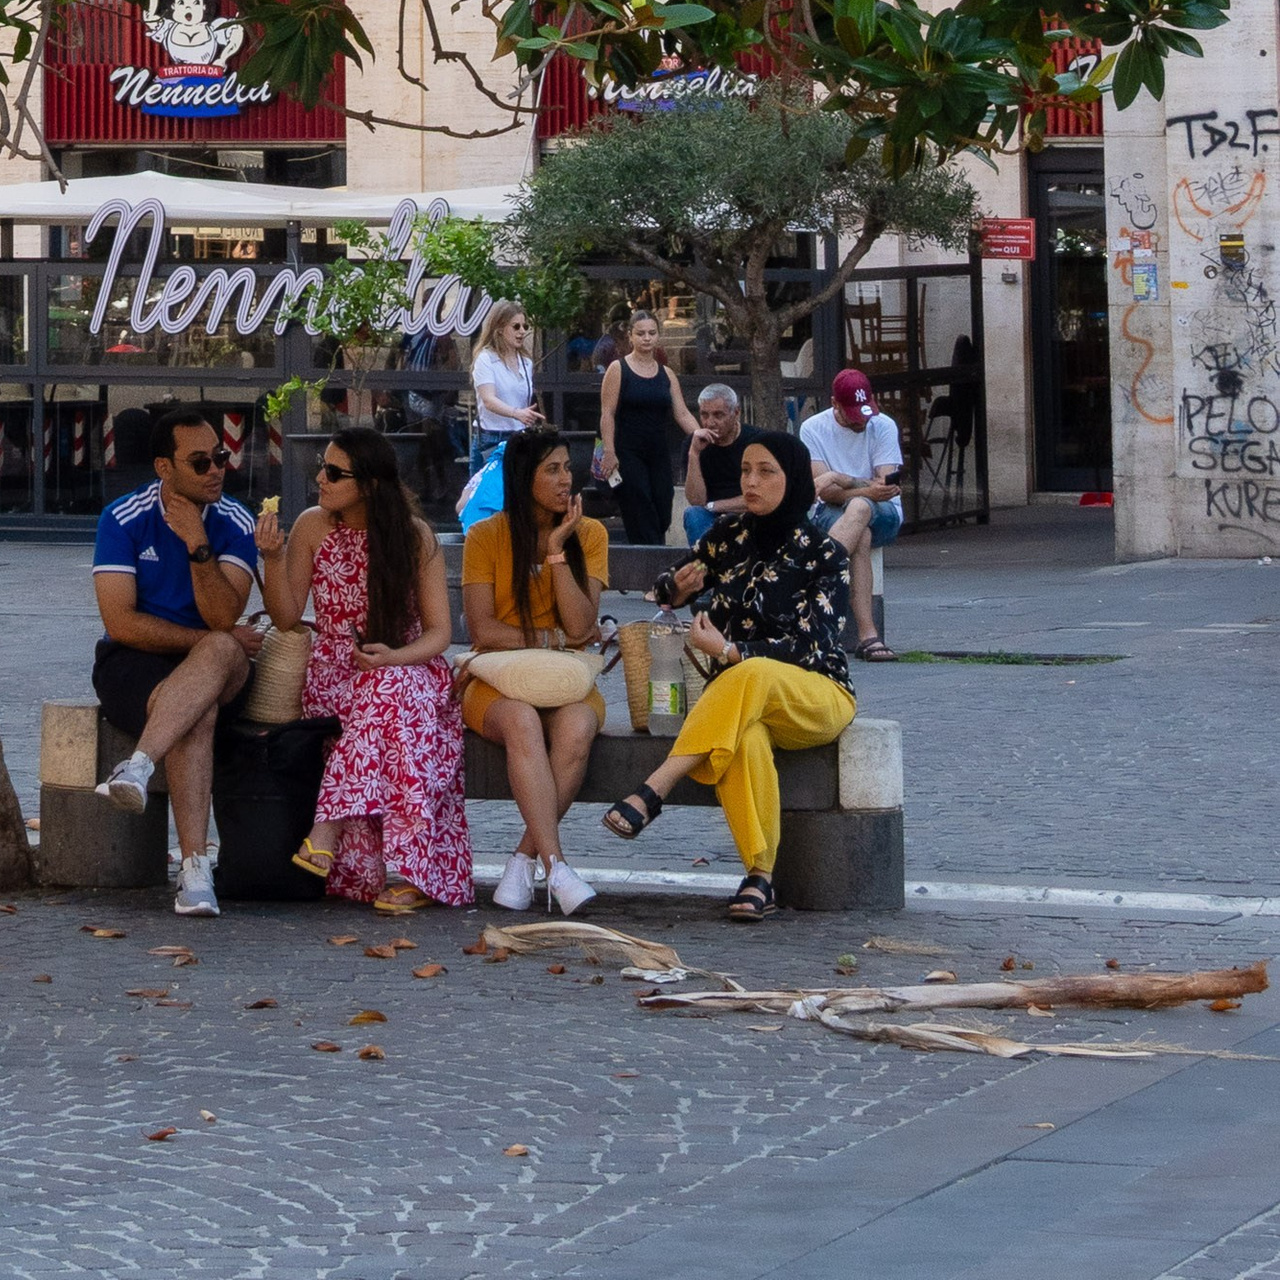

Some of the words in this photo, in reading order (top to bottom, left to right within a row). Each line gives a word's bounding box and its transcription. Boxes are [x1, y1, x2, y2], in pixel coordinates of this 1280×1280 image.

[163, 65, 207, 76] TRATTORIA
[207, 67, 219, 76] DA
[1003, 246, 1020, 254] QUI
